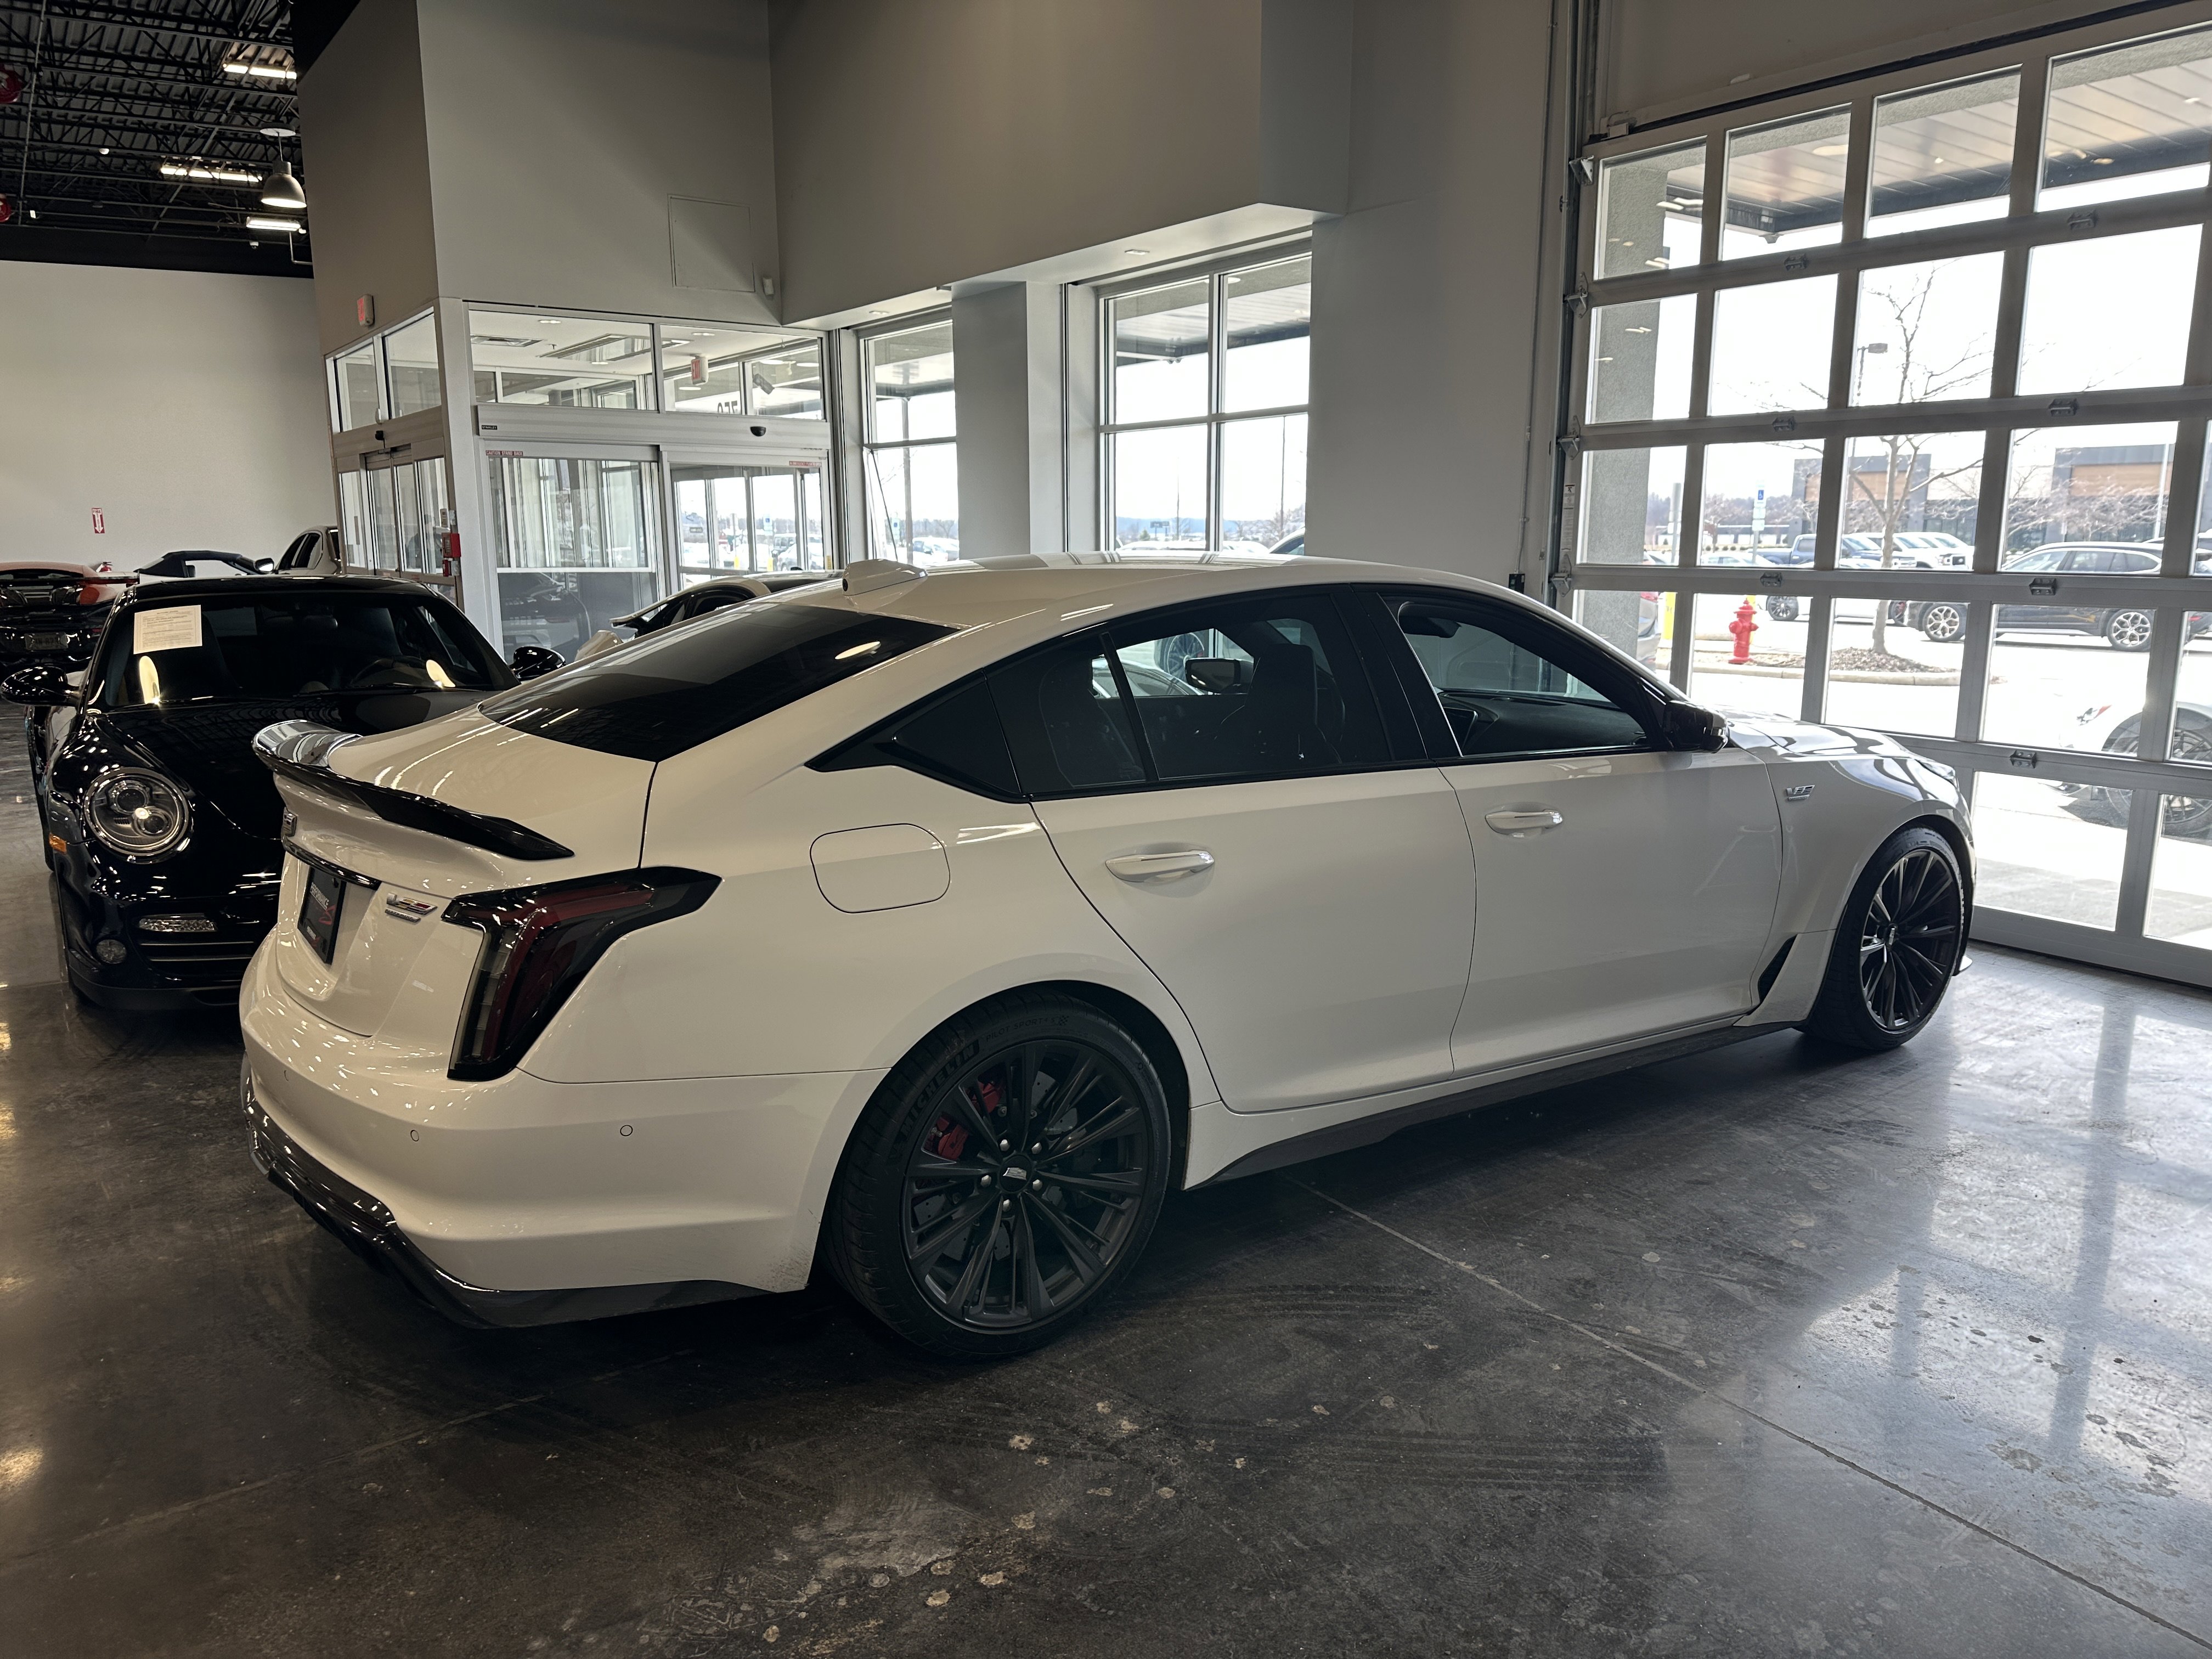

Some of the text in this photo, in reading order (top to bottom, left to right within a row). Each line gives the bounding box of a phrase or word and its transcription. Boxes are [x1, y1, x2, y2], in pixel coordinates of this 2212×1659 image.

[986, 1026, 1010, 1041] PILOT
[1013, 1018, 1044, 1029] SPORT
[900, 1043, 975, 1137] MICHELIN
